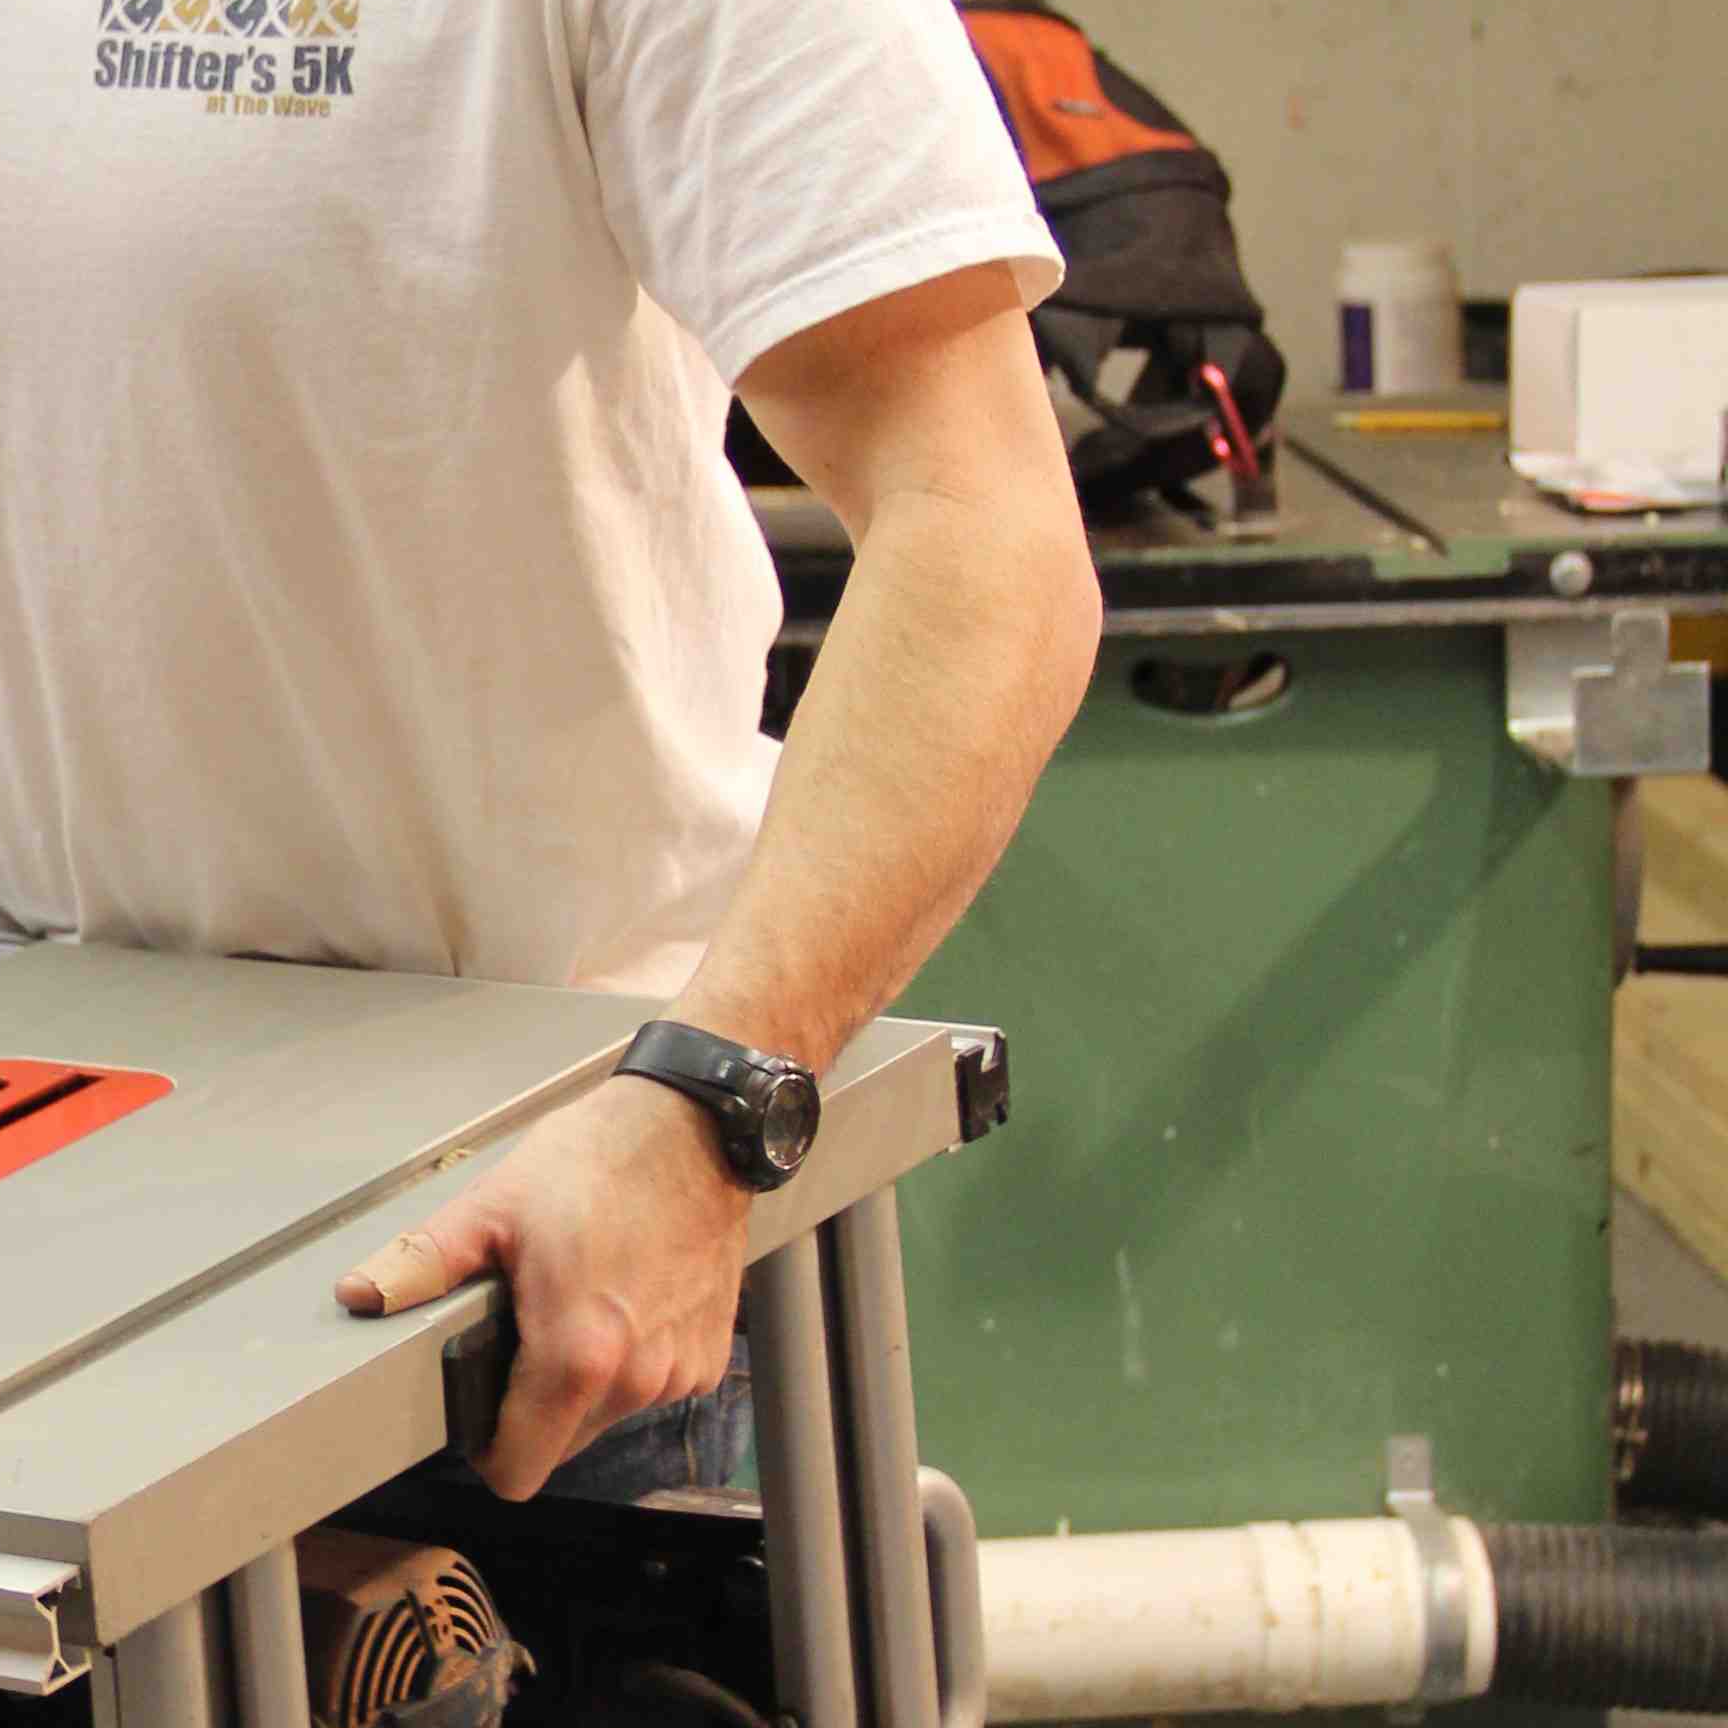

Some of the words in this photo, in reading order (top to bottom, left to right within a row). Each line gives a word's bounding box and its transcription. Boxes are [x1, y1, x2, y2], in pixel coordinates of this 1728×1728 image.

[94, 39, 276, 94] Shifter's
[292, 44, 355, 95] 5K
[234, 96, 270, 115] The
[273, 96, 332, 118] Wave
